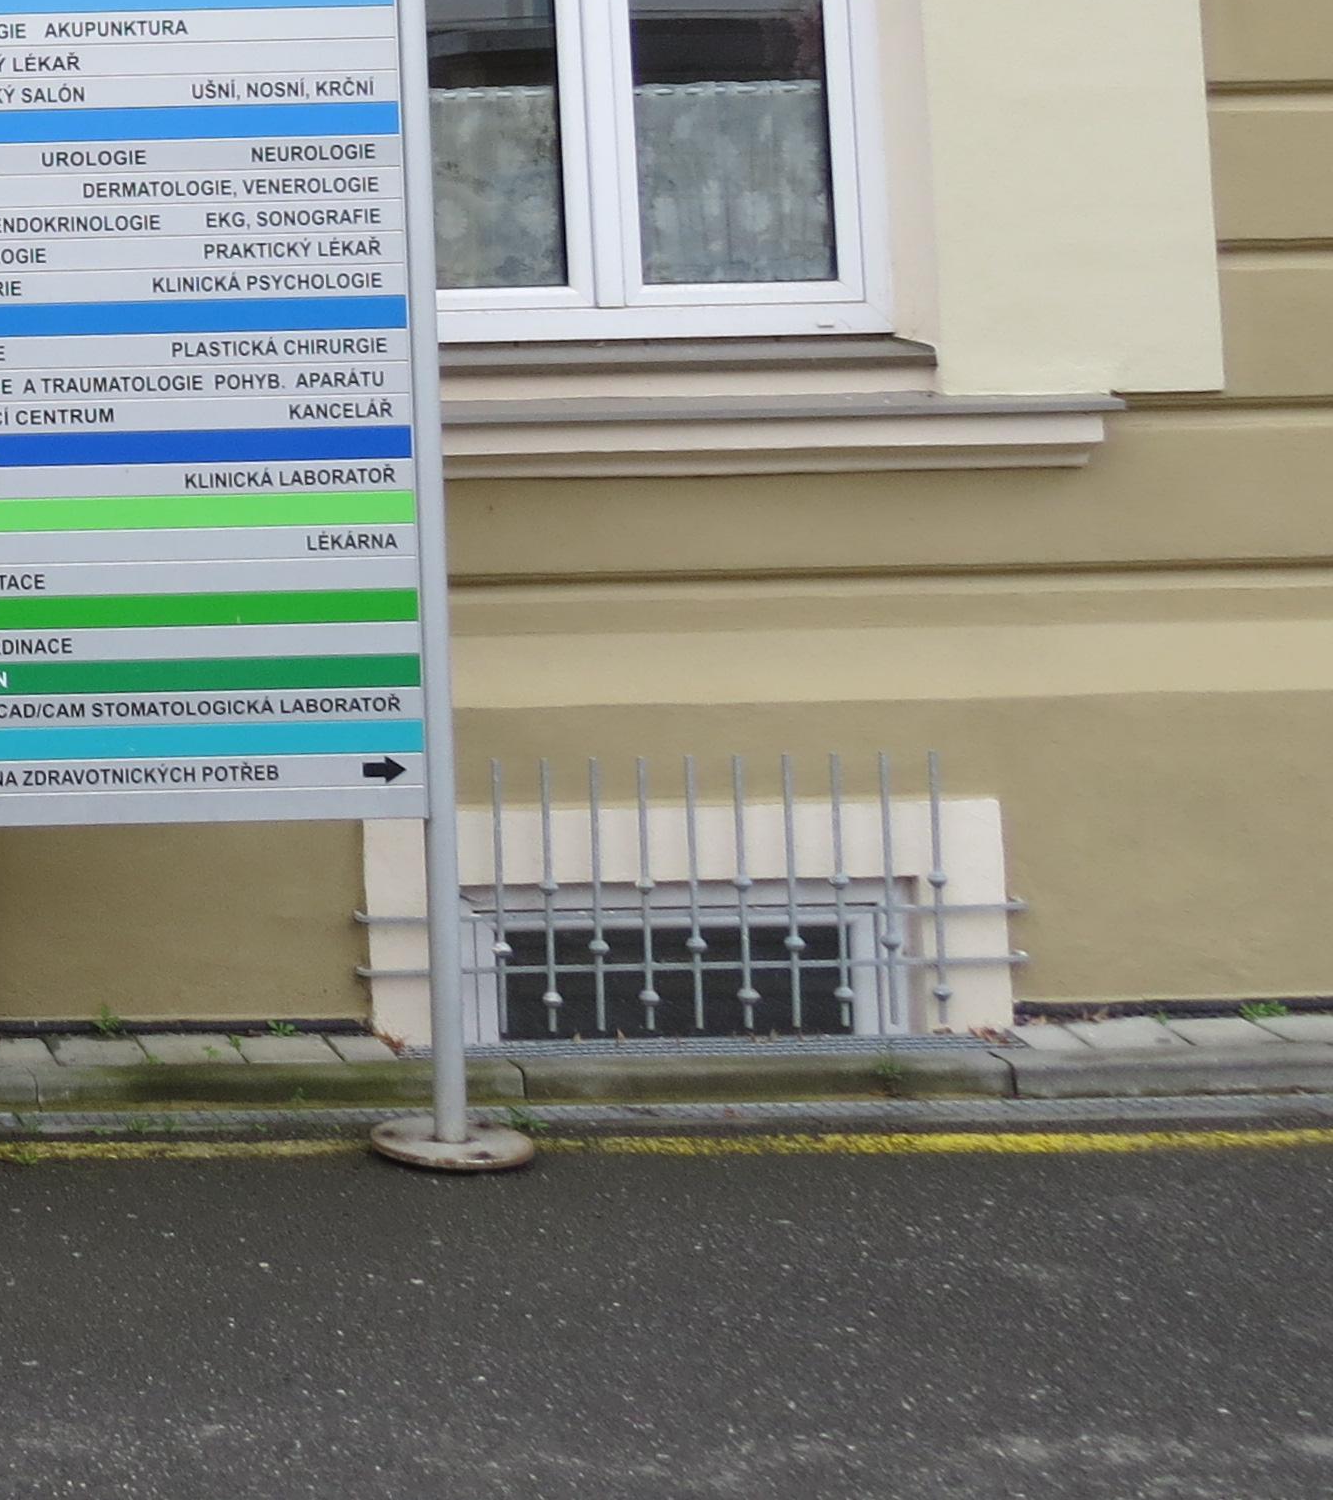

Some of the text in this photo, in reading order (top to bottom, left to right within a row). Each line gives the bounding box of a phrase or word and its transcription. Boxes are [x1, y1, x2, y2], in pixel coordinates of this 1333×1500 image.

[44, 19, 188, 38] AKUPUNKTURA
[12, 52, 81, 73] LÉKAŘ
[21, 83, 85, 104] SALÓN
[191, 76, 374, 100] UŠNÍ, NOSNÍ, KRČNÍ
[41, 149, 147, 168] UROLOGIE
[251, 143, 376, 163] NEUROLOGIE
[83, 176, 379, 199] DERMATOLOGIE, VENEROLOGIE
[206, 208, 382, 229] EKG, SONOGRAFIE
[204, 236, 382, 260] PRAKTICKÝ LÉKAŘ
[152, 272, 383, 293] KLINICKÁ PSYCHOLOGIE
[171, 336, 388, 358] PLASTICKÁ CHIRURGIE
[23, 378, 36, 394] A
[40, 375, 203, 394] TRAUMATOLOGIE
[214, 373, 285, 390] POHYB.
[295, 369, 384, 388] APARÁTU
[15, 407, 114, 426] CENTRUM
[289, 398, 393, 420] KANCELÁŘ
[184, 463, 396, 489] KLINICKÁ LABORATOŘ
[306, 531, 398, 551] LÉKÁRNA
[91, 697, 275, 718] STOMATOLOGICKÁ
[280, 693, 401, 714] LABORATOŘ
[22, 764, 196, 787] ZDRAVOTNICKÝCH
[202, 762, 279, 782] POTŘEB
